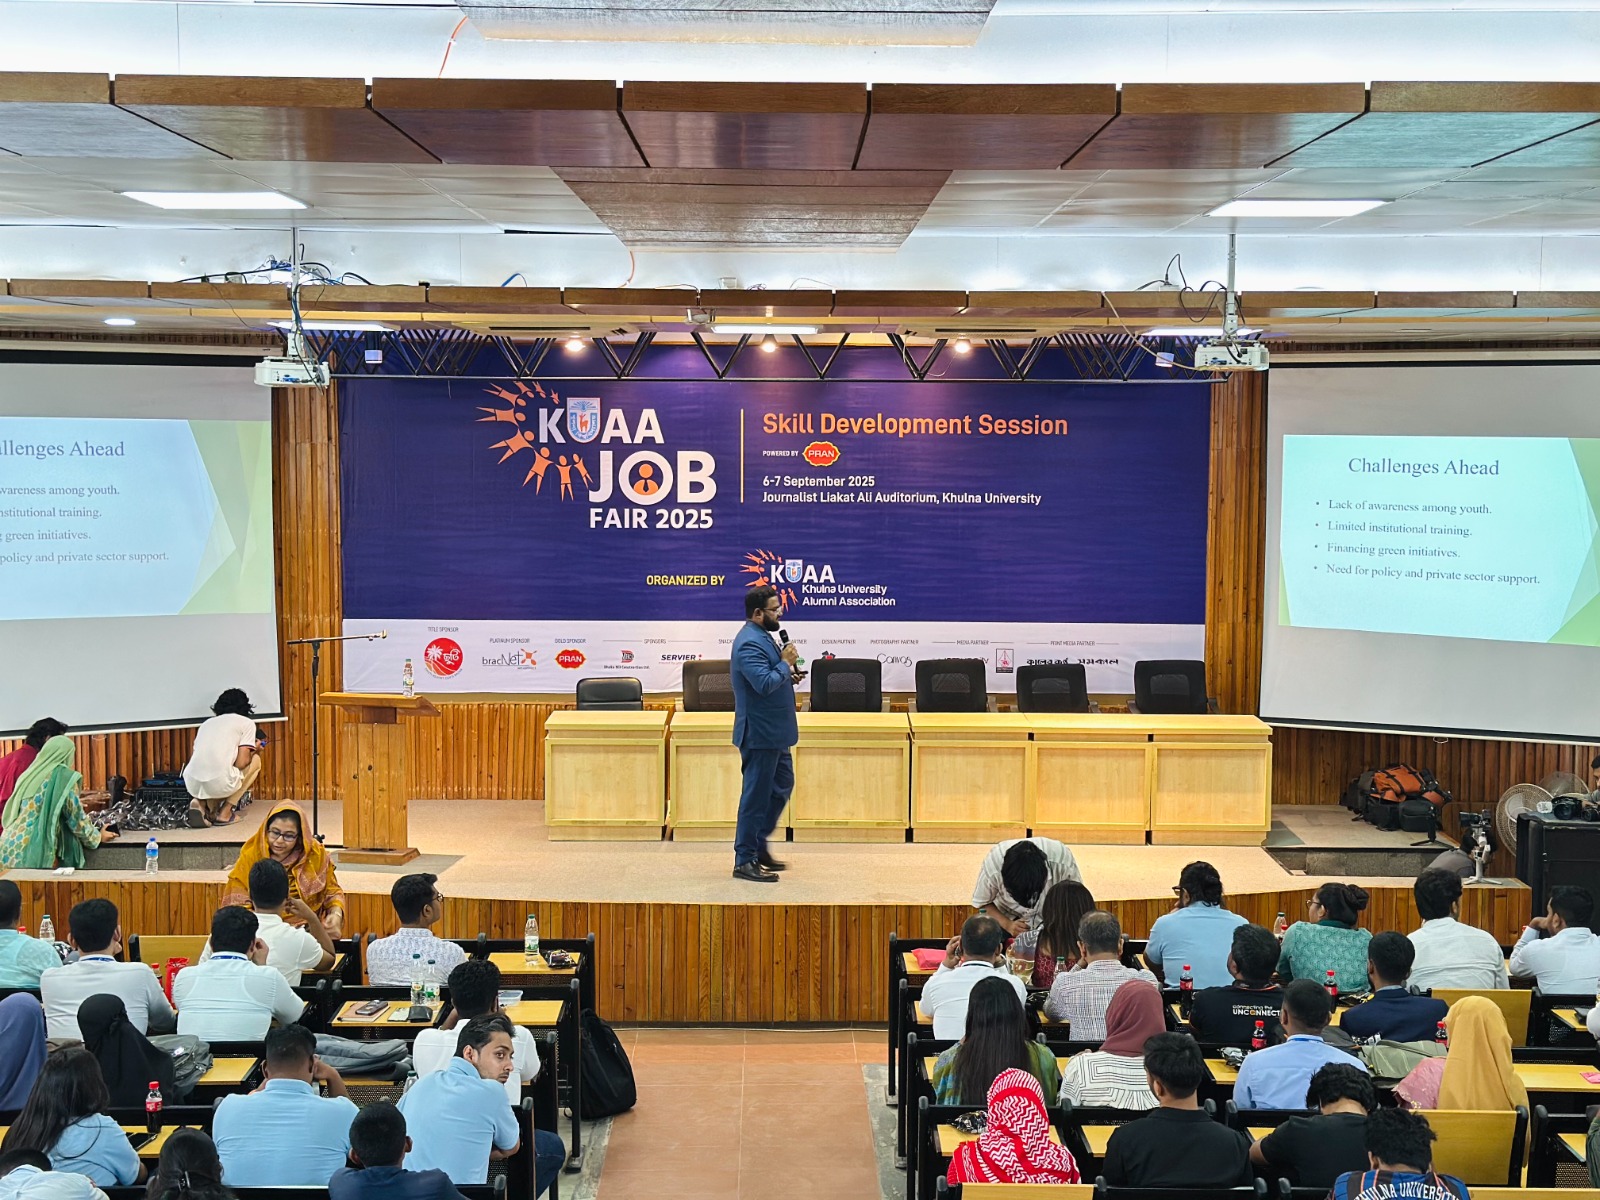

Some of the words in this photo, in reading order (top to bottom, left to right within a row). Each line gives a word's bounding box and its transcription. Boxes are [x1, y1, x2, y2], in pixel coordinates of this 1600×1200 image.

[538, 397, 665, 444] KUAA
[763, 412, 815, 434] Skill
[820, 413, 972, 438] Development
[978, 414, 1068, 435] Session
[0, 439, 65, 460] llenges
[69, 440, 125, 457] Ahead
[807, 449, 835, 459] PRAN
[1348, 457, 1439, 477] Challenges
[1444, 459, 1500, 476] Ahead
[588, 450, 717, 506] JOB
[762, 475, 782, 487] 6-7
[783, 475, 846, 489] September
[848, 475, 875, 487] 2025
[49, 487, 85, 497] among
[87, 484, 120, 497] youth.
[762, 491, 819, 503] Journalist
[820, 491, 856, 503] Liakat
[857, 492, 873, 503] Ali
[875, 492, 940, 504] Auditorium,
[942, 493, 982, 504] Khulna
[985, 493, 1042, 506] University
[0, 507, 56, 517] nstitutional
[59, 507, 102, 518] training.
[1329, 500, 1352, 510] Lack
[1355, 500, 1368, 511] of
[1368, 503, 1419, 512] awareness
[1422, 504, 1457, 515] among
[1460, 502, 1492, 515] youth.
[590, 508, 648, 528] FAIR
[656, 509, 714, 529] 2025
[5, 532, 35, 543] green
[37, 529, 91, 540] initiatives.
[1328, 521, 1366, 532] Limited
[1369, 522, 1427, 534] institutional
[1430, 524, 1472, 537] training.
[0, 552, 32, 565] policy
[35, 552, 54, 562] and
[57, 551, 93, 565] private
[96, 552, 126, 562] sector
[129, 551, 169, 564] support.
[1327, 543, 1375, 555] Financing
[1378, 547, 1405, 558] green
[1408, 546, 1460, 558] initiatives.
[771, 559, 835, 583] KUAA
[1326, 563, 1352, 574] Need
[1355, 565, 1369, 575] for
[1371, 566, 1402, 579] policy
[1405, 568, 1423, 578] and
[1425, 569, 1461, 581] private
[1464, 571, 1495, 582] sector
[1498, 572, 1540, 585] support.
[646, 575, 708, 586] ORGANIZED
[711, 576, 725, 586] BY
[802, 584, 836, 594] Khulna
[838, 585, 887, 596] University
[802, 596, 837, 606] Alumni
[840, 597, 896, 606] Association
[482, 651, 523, 666] bracNet
[558, 655, 582, 663] PRAN
